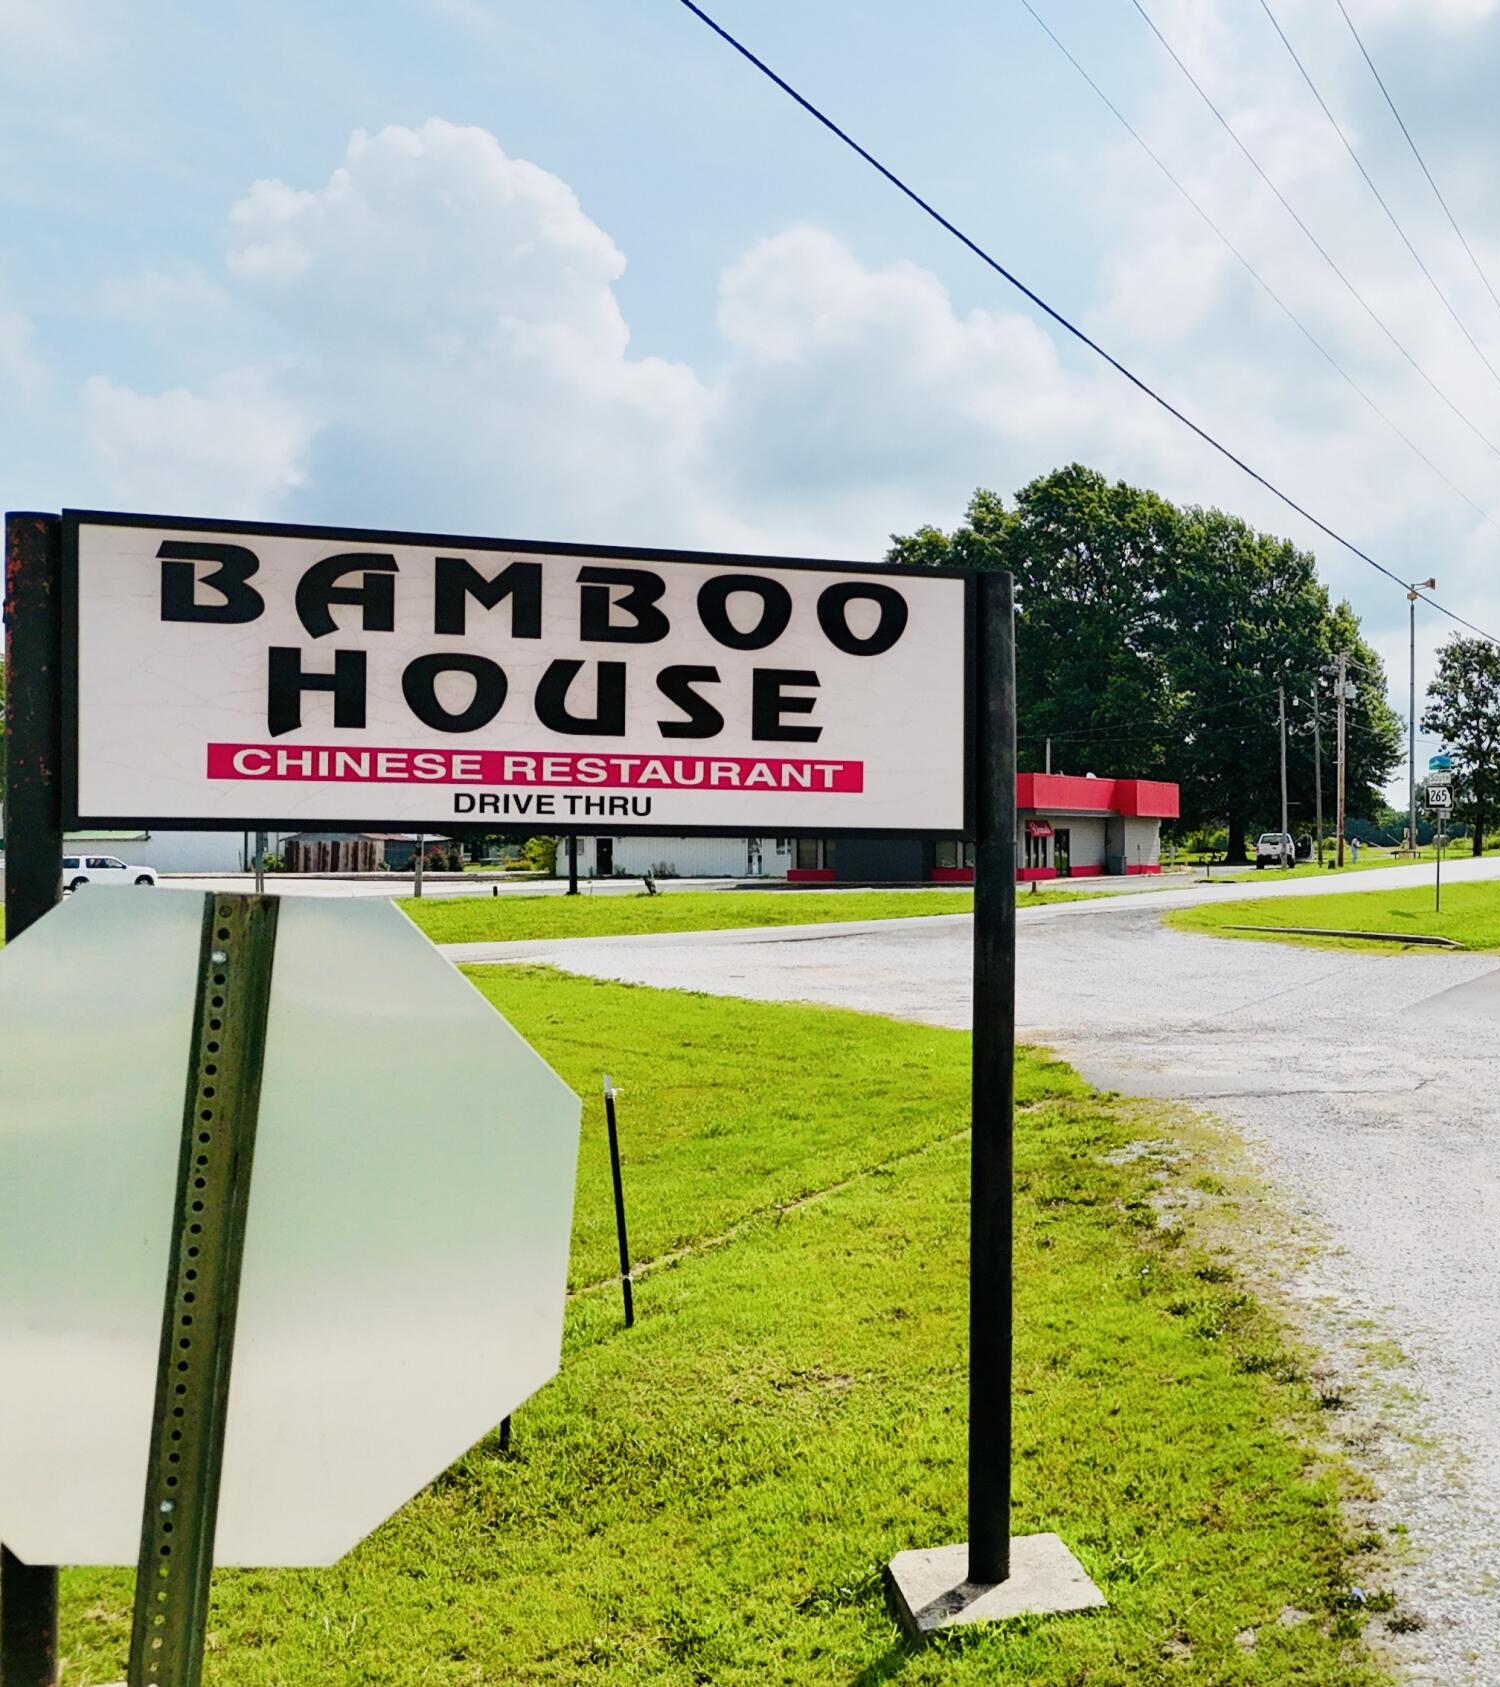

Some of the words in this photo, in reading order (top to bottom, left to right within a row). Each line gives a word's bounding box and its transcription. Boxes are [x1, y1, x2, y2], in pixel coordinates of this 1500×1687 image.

[156, 540, 908, 656] BAMBOO
[268, 646, 823, 742] HOUSE
[233, 748, 483, 783] CHINESE
[503, 756, 844, 788] RESTAURANT
[454, 793, 556, 816] DRIVE
[562, 795, 652, 817] THRU
[1430, 789, 1447, 802] 265
